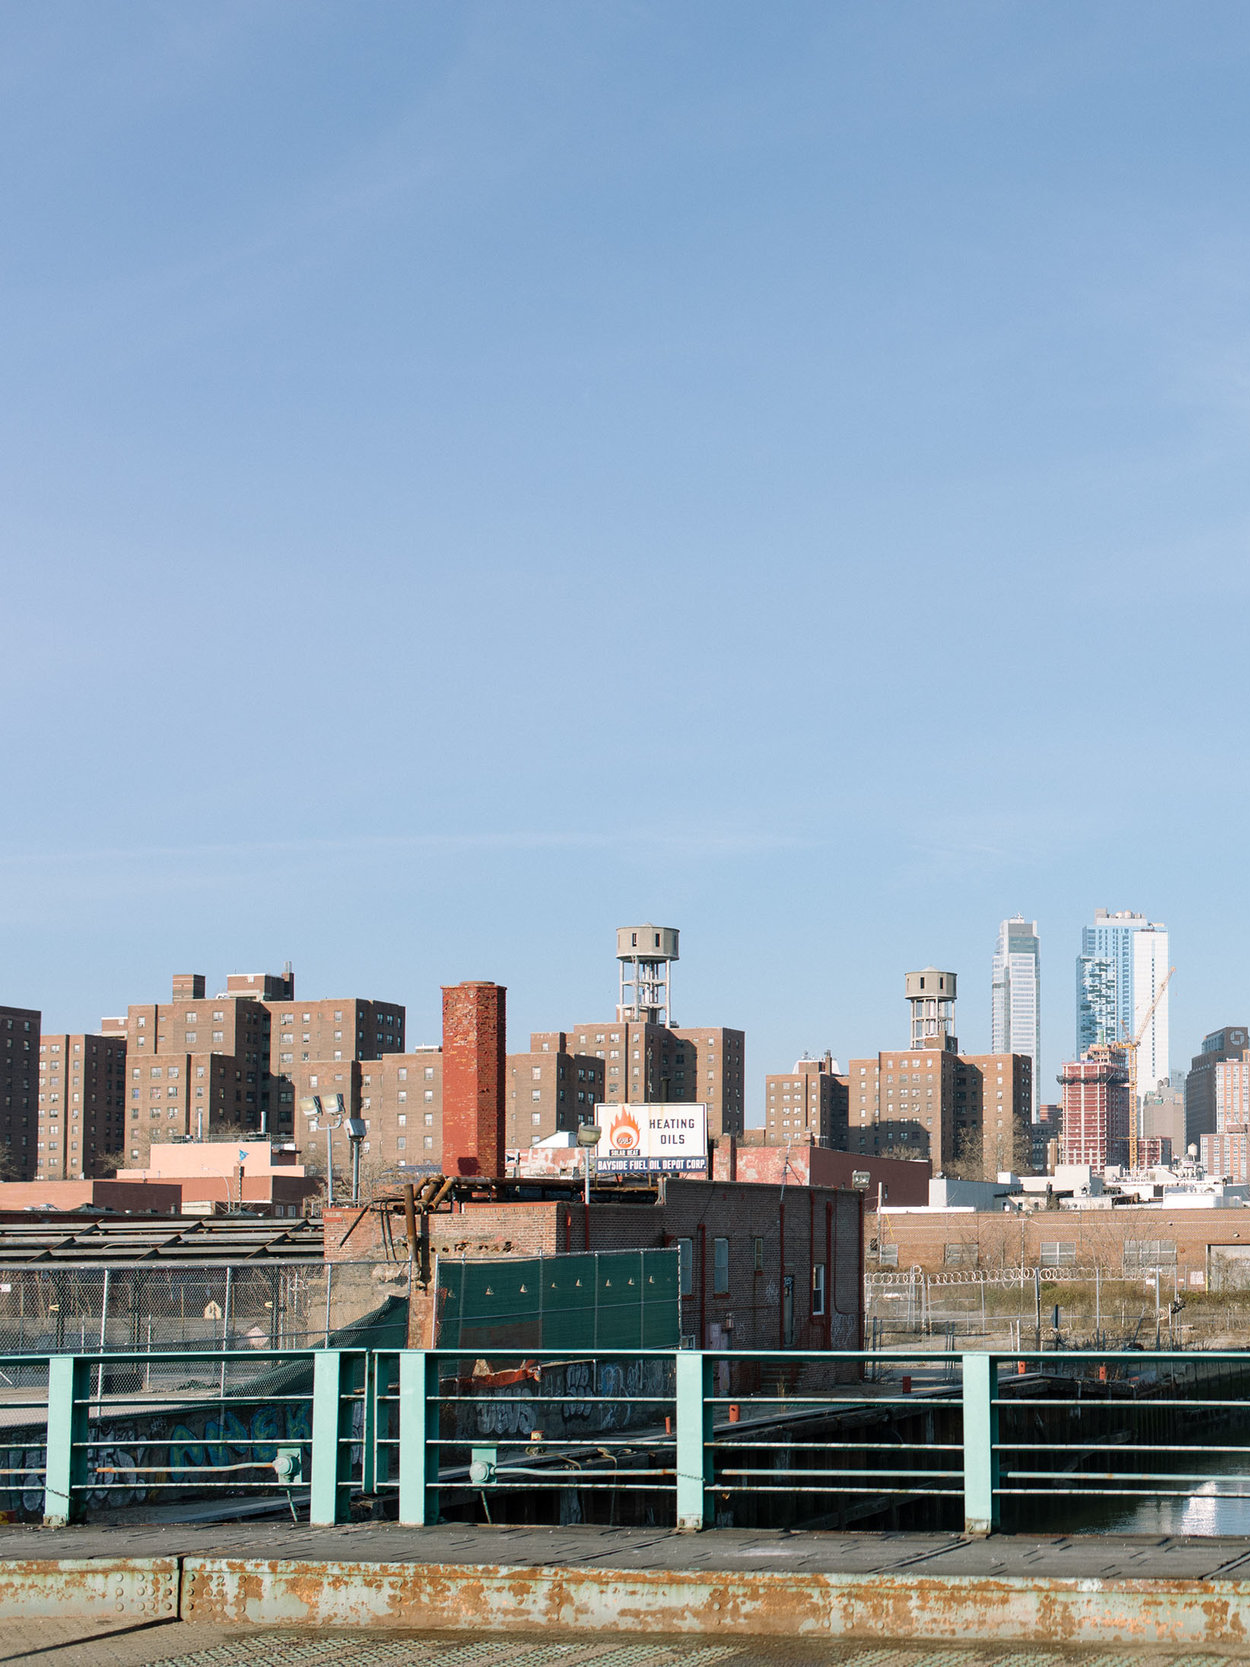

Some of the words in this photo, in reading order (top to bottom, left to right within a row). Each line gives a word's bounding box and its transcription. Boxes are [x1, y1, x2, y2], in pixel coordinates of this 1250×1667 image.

[649, 1119, 695, 1129] HEATING
[660, 1134, 685, 1145] OILS
[597, 1160, 628, 1171] BAYSIDE
[629, 1160, 648, 1170] FUEL
[649, 1159, 662, 1170] OIL
[662, 1159, 684, 1169] DEPOT
[686, 1159, 707, 1169] CORP.
